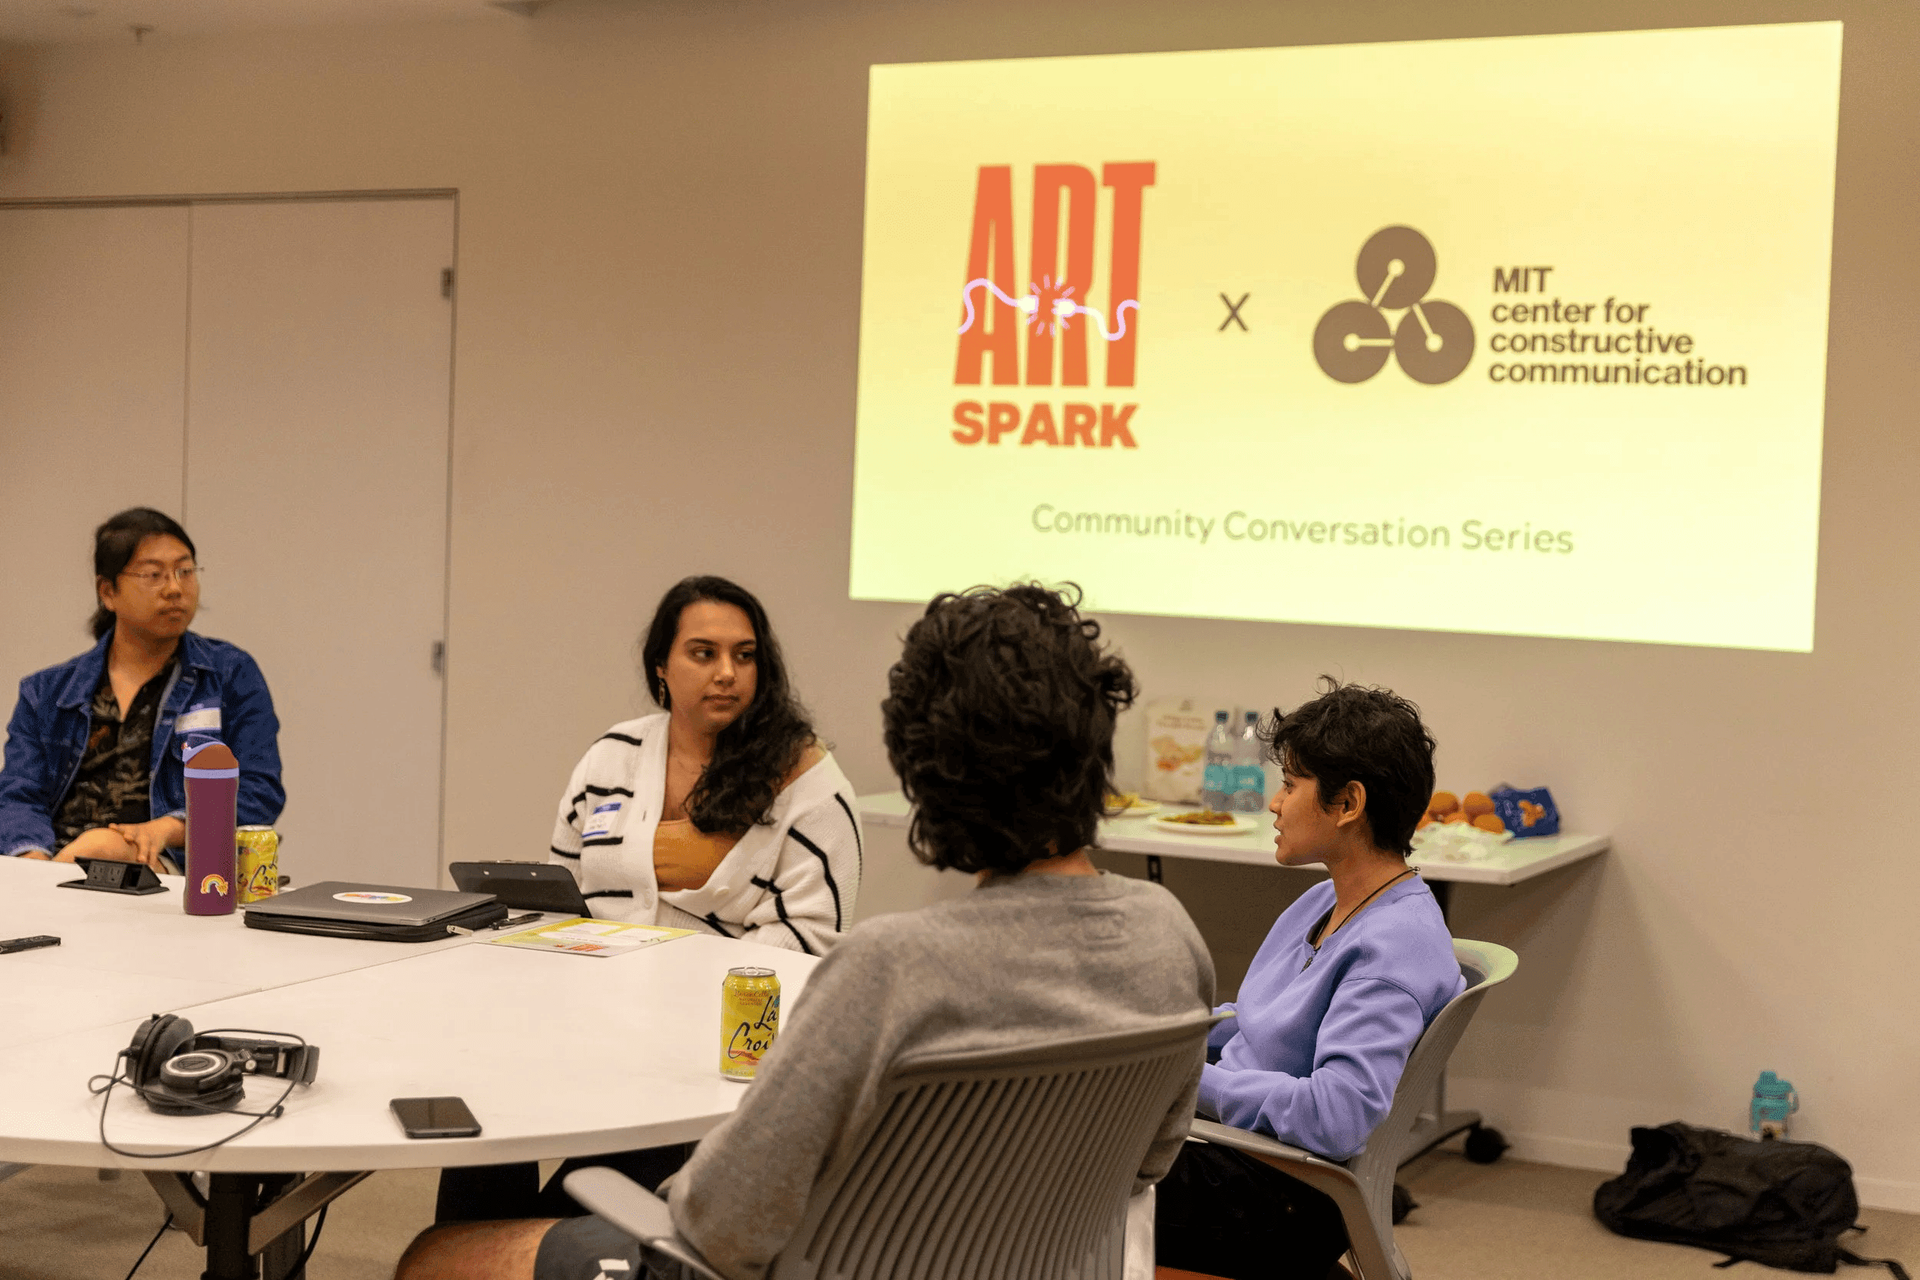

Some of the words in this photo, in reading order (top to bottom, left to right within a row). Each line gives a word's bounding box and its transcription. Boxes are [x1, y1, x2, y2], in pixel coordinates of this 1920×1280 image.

[954, 160, 1157, 388] ART
[1493, 266, 1554, 294] MIT
[1491, 300, 1595, 324] center
[1604, 297, 1650, 324] for
[1490, 328, 1695, 355] constructive
[1488, 357, 1748, 387] communication
[951, 400, 1140, 449] SPARK
[1031, 503, 1215, 544] Community
[1223, 510, 1451, 549] Conversation
[1461, 519, 1574, 554] Series
[753, 995, 777, 1031] La
